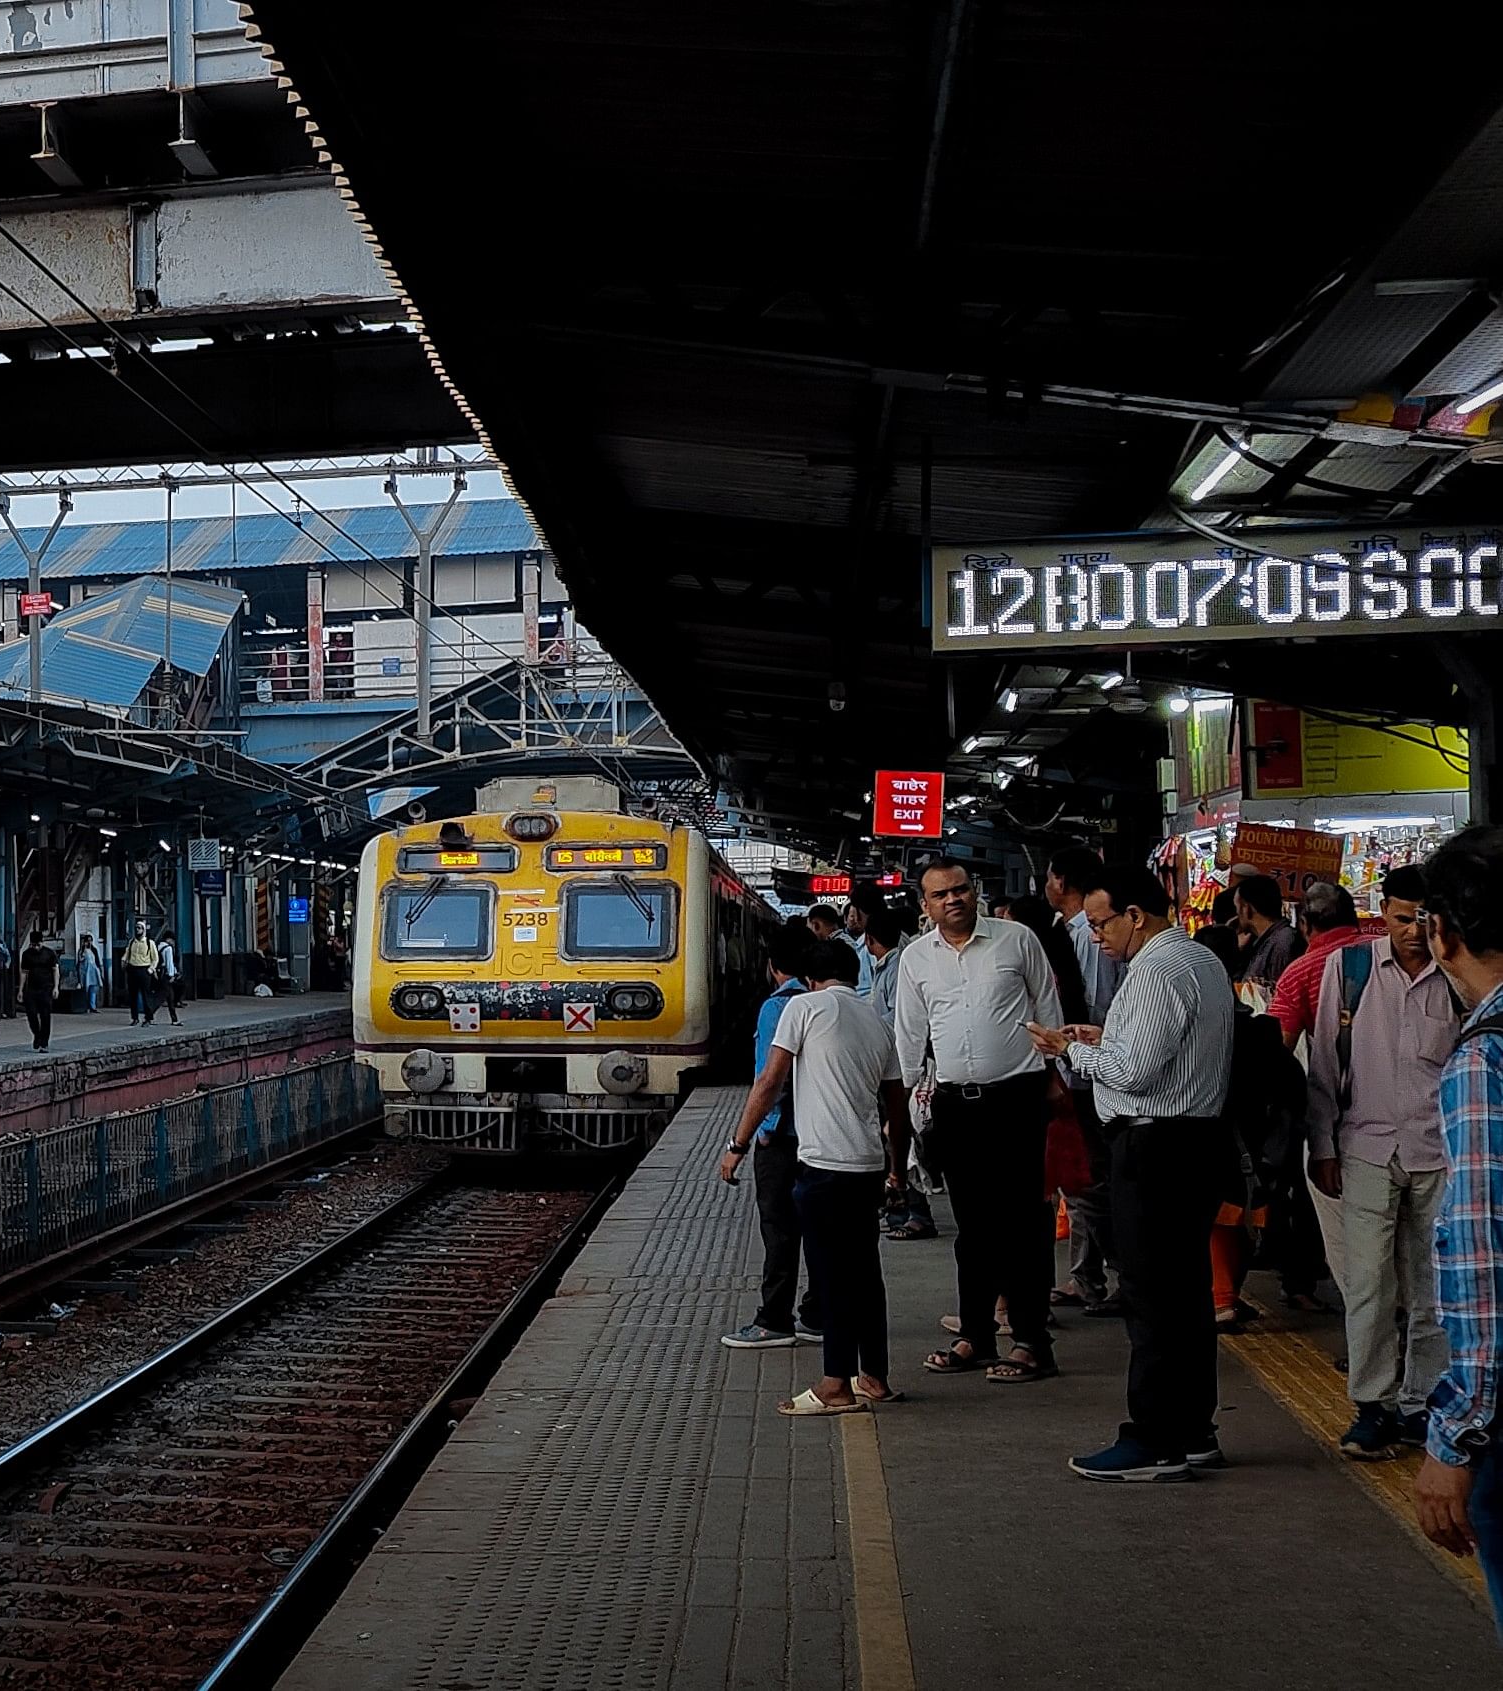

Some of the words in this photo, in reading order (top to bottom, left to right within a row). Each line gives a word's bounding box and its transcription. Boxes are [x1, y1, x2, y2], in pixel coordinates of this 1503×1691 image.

[891, 777, 929, 791] बाहेर
[891, 794, 928, 806] बाहर
[893, 809, 924, 820] EXIT
[1238, 829, 1298, 849] FOUNTAIN
[1304, 836, 1339, 854] SODA
[502, 912, 548, 927] 5238
[493, 947, 559, 976] ICF
